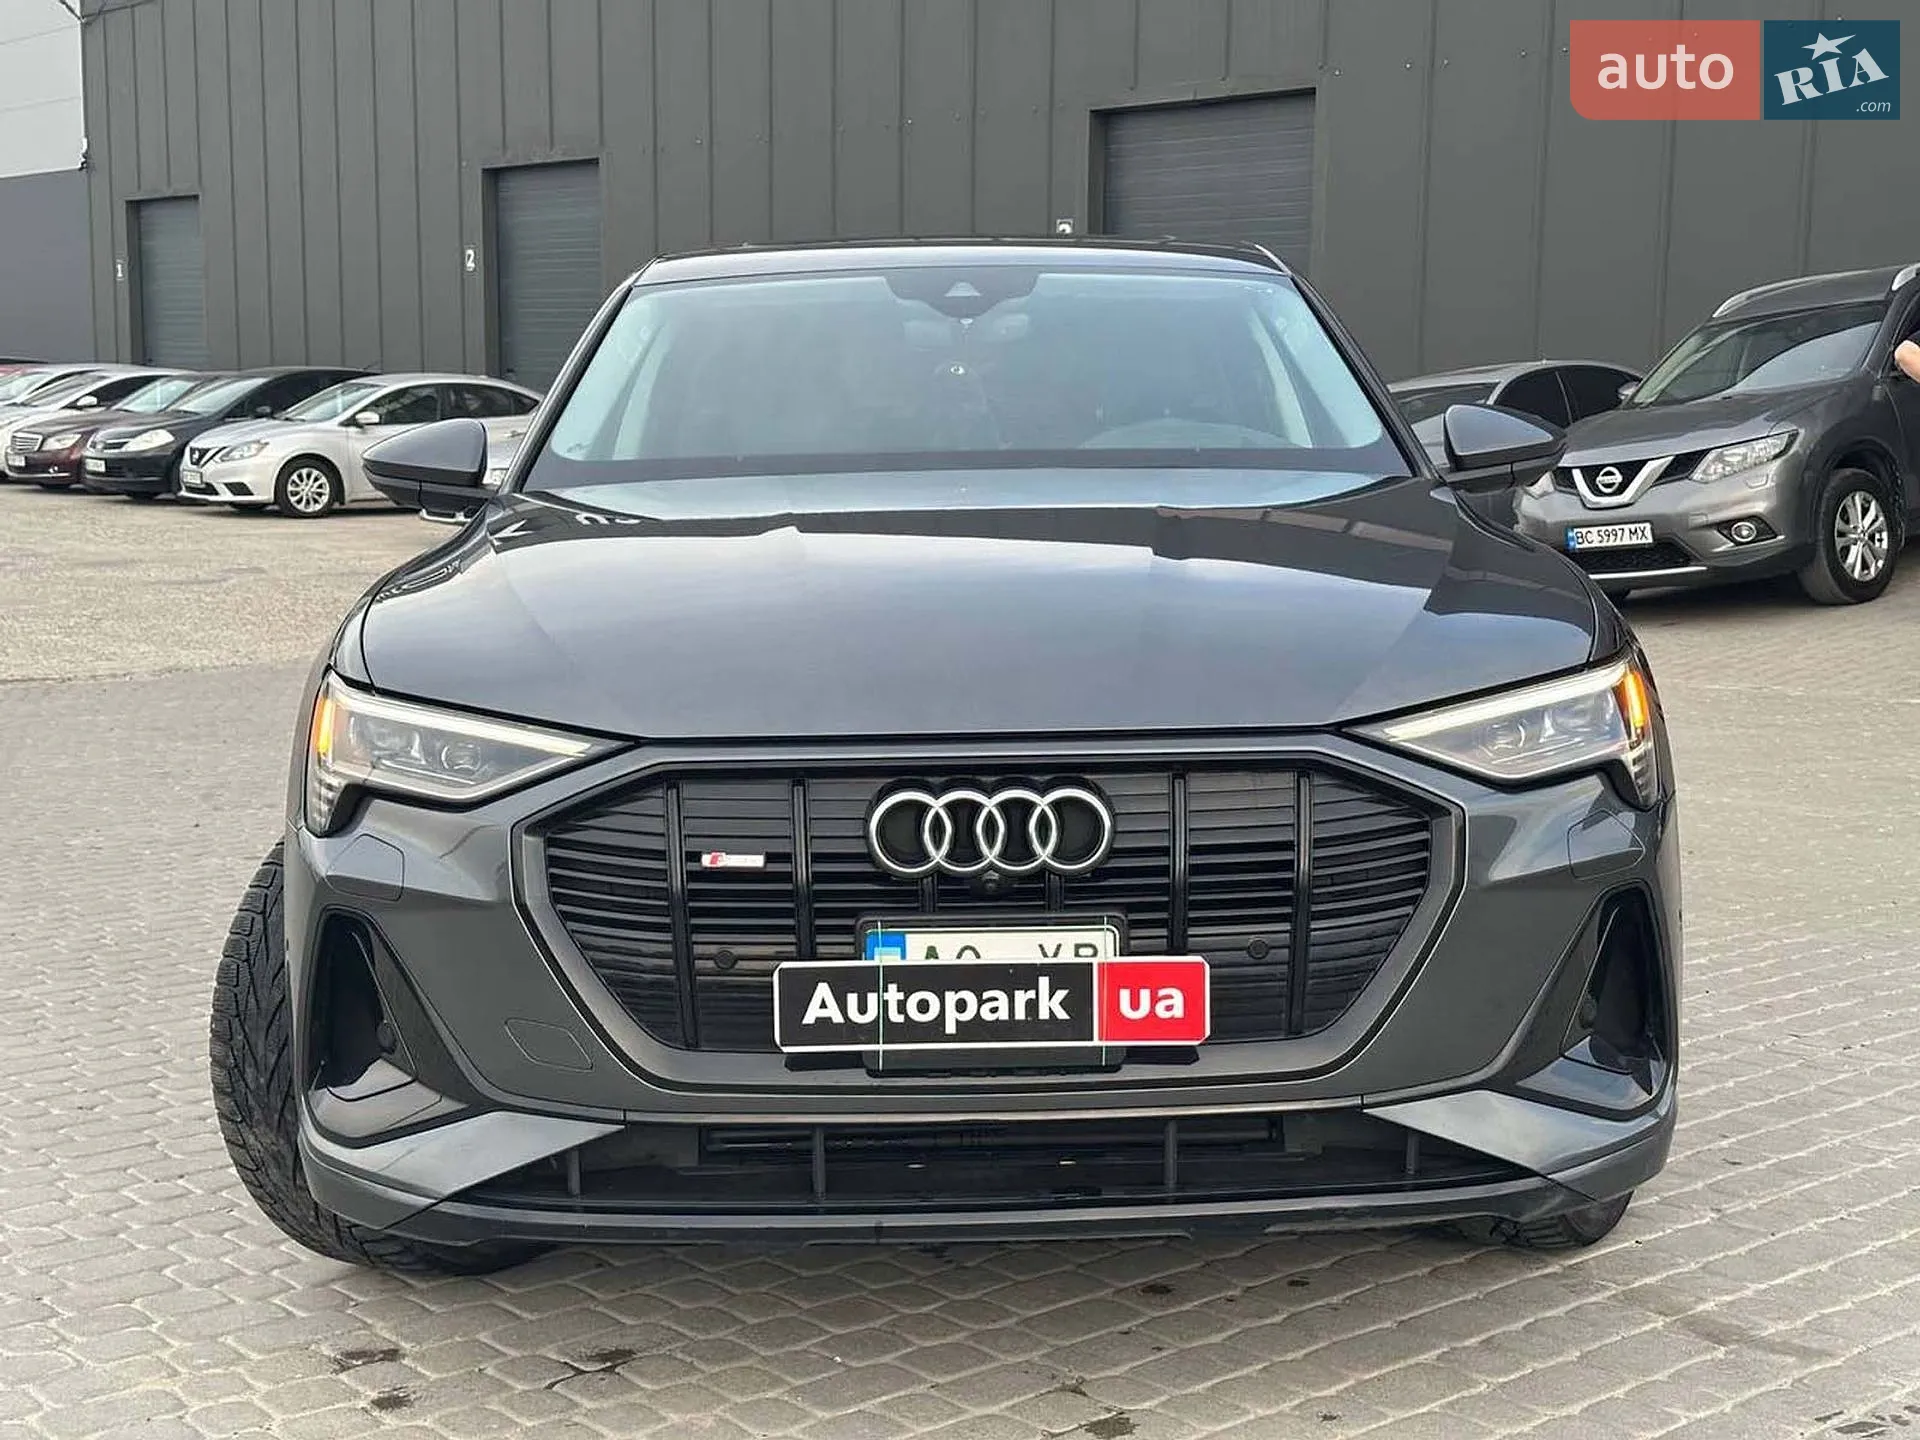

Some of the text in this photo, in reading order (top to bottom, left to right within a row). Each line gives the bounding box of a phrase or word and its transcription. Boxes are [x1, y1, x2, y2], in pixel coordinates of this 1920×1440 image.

[465, 249, 476, 271] 2
[1574, 525, 1649, 545] BC 5997 MX
[801, 975, 1187, 1035] Autopark ua
